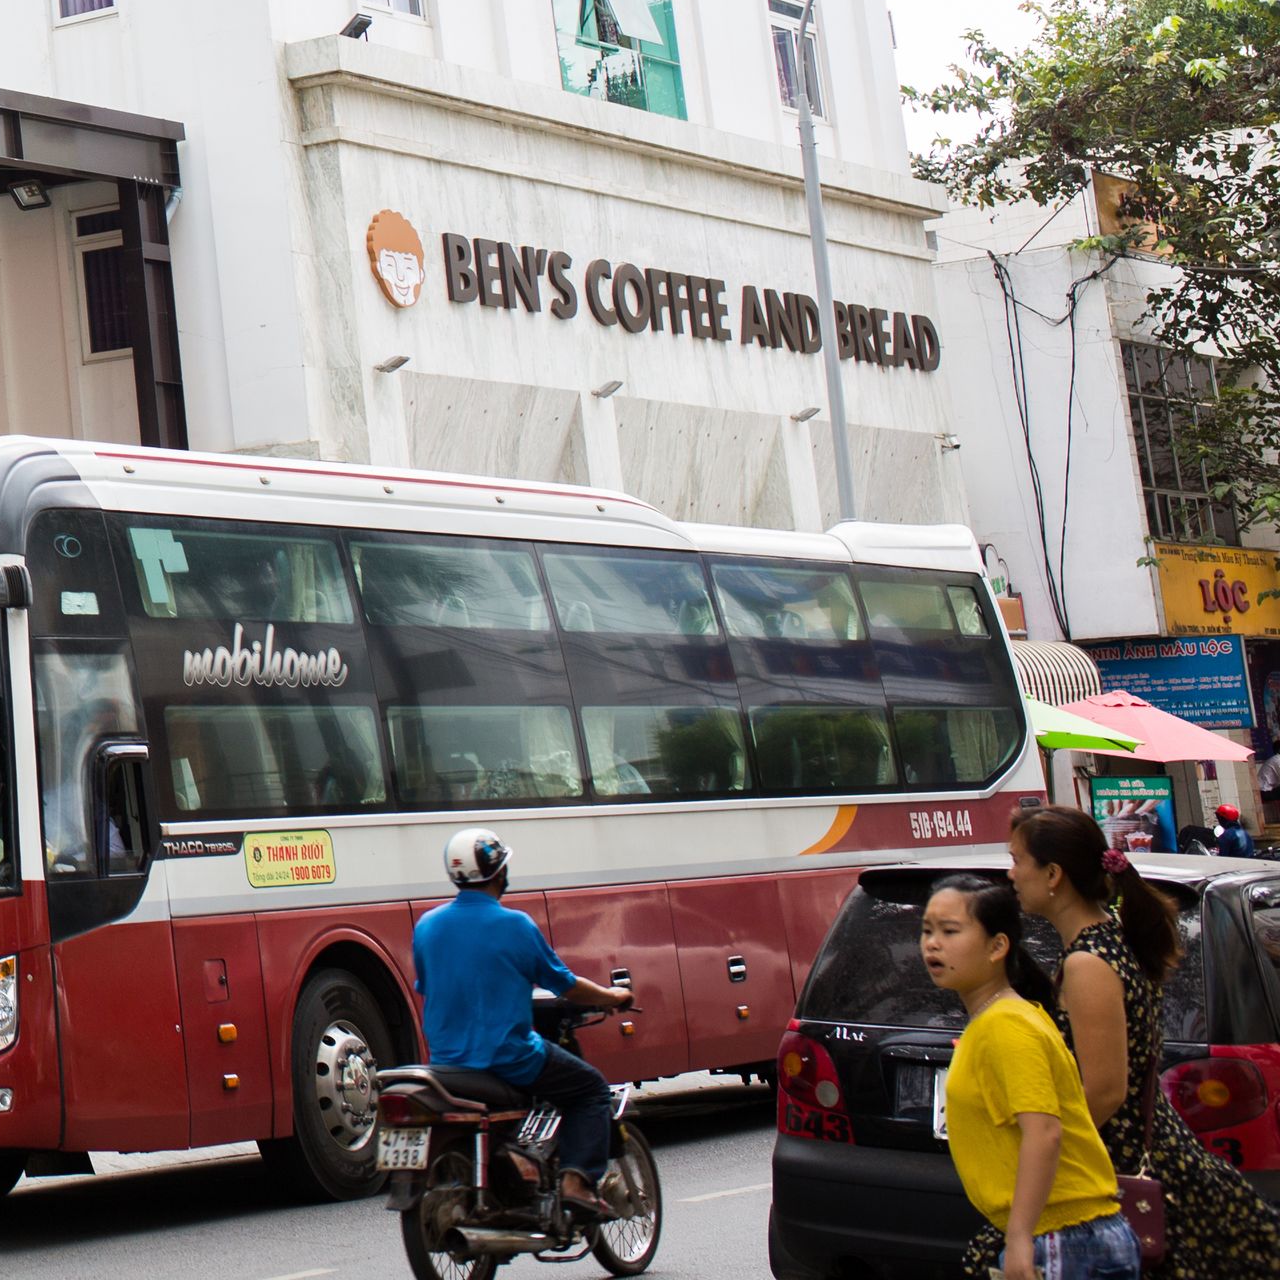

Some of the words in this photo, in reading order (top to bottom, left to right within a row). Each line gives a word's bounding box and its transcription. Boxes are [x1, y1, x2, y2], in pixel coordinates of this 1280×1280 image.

[442, 232, 578, 320] BEN'S
[585, 258, 732, 341] COFFEE
[741, 285, 822, 355] AND
[831, 300, 941, 372] BREAD
[1199, 569, 1251, 624] LỘC
[183, 622, 348, 687] mobihome
[1124, 641, 1156, 659] ẢNH
[1160, 640, 1197, 658] MÀU
[1200, 638, 1233, 659] LỘC
[909, 809, 973, 839] 51B-194.44
[164, 841, 203, 855] THACO
[290, 866, 310, 881] 1900
[312, 864, 330, 879] 6079
[785, 1103, 850, 1144] 643
